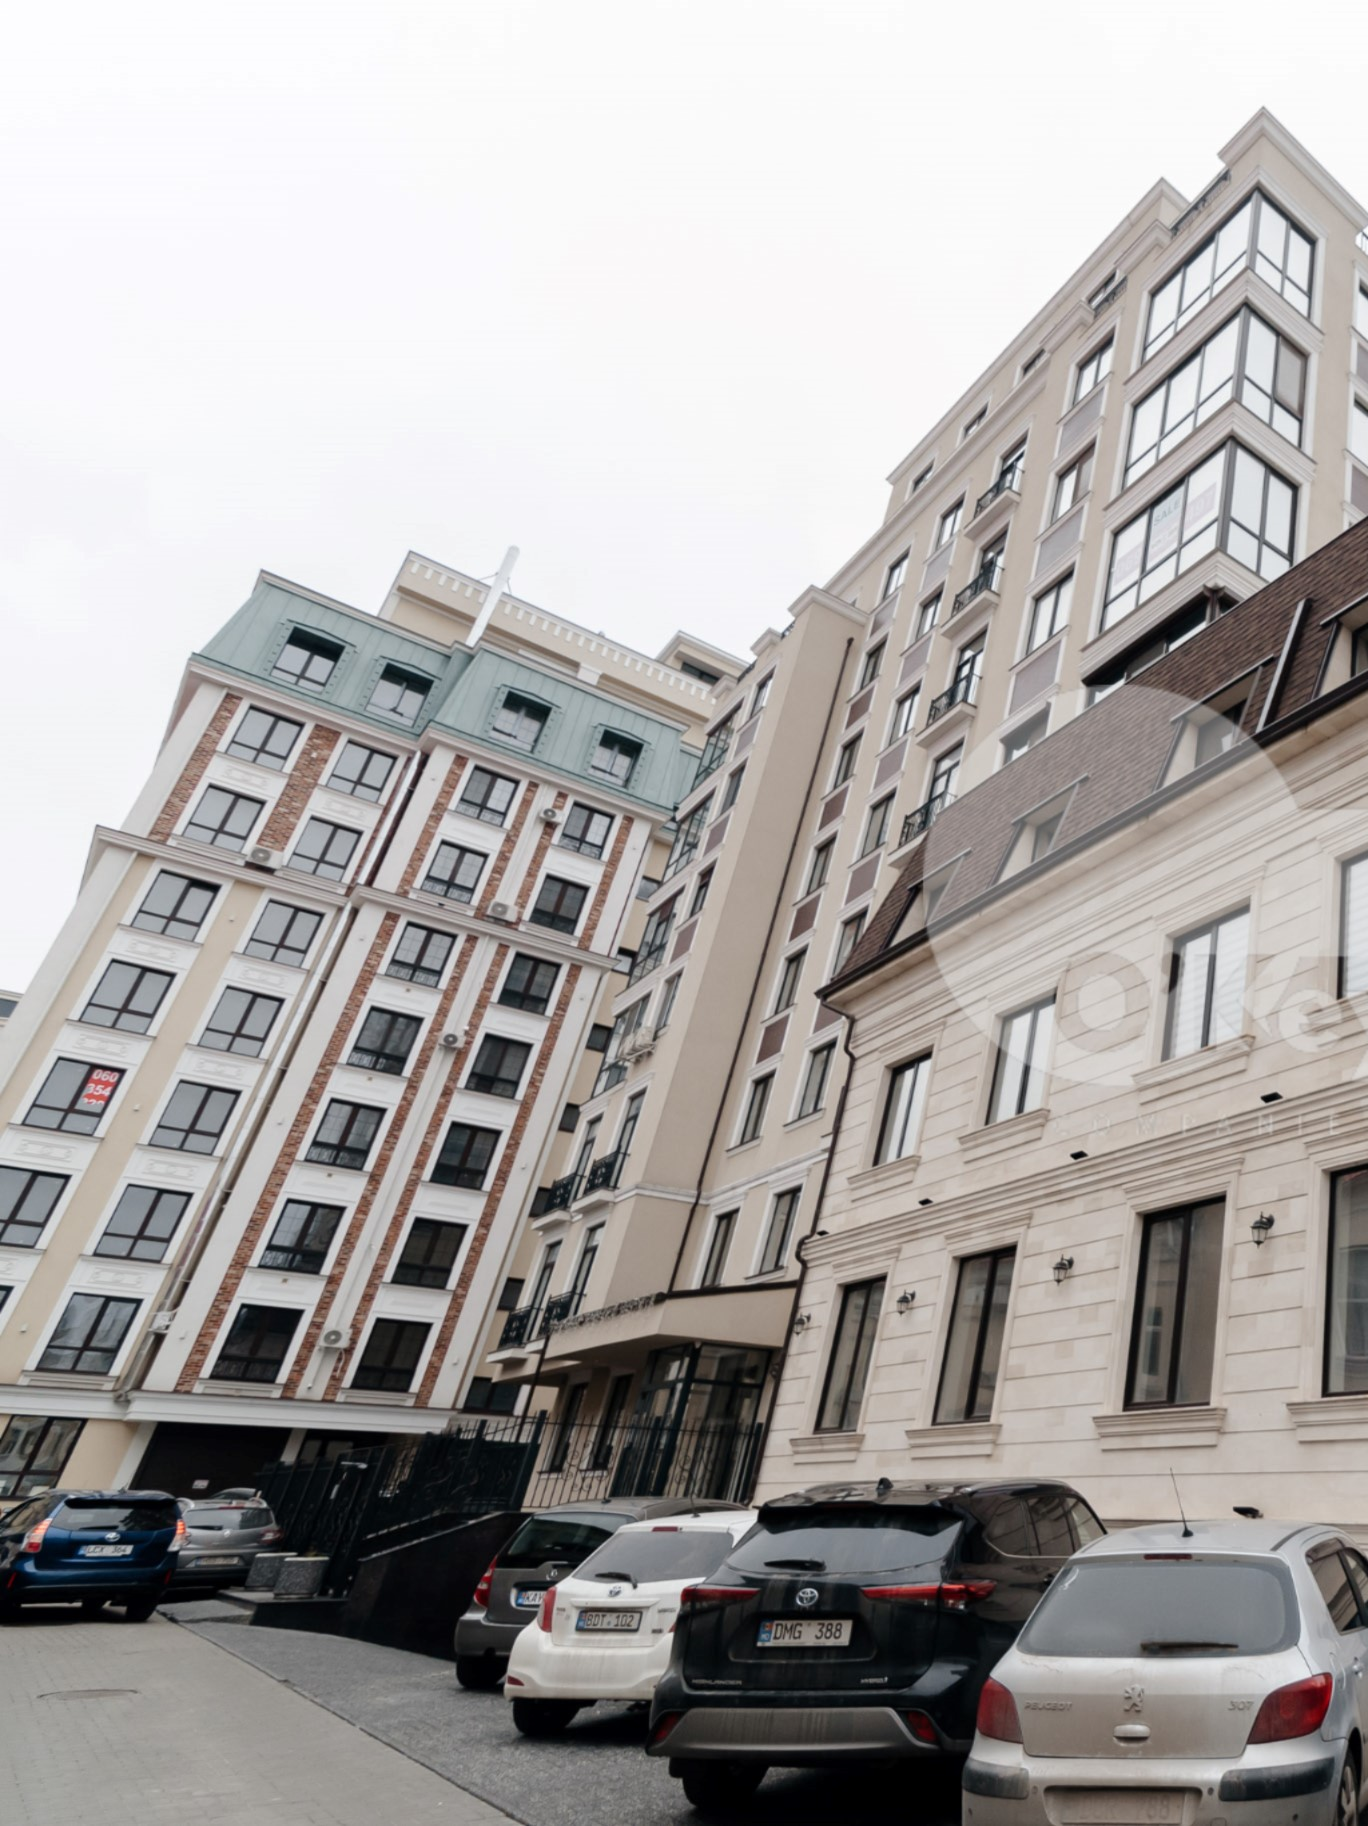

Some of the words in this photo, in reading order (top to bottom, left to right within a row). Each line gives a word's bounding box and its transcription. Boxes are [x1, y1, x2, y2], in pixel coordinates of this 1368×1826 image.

[92, 1069, 119, 1082] 060
[586, 1614, 607, 1627] BDT
[613, 1614, 634, 1627] 102
[773, 1622, 803, 1640] DMG
[815, 1622, 843, 1640] 388
[1024, 1701, 1072, 1711] PEUGEOT
[1228, 1701, 1254, 1711] 307
